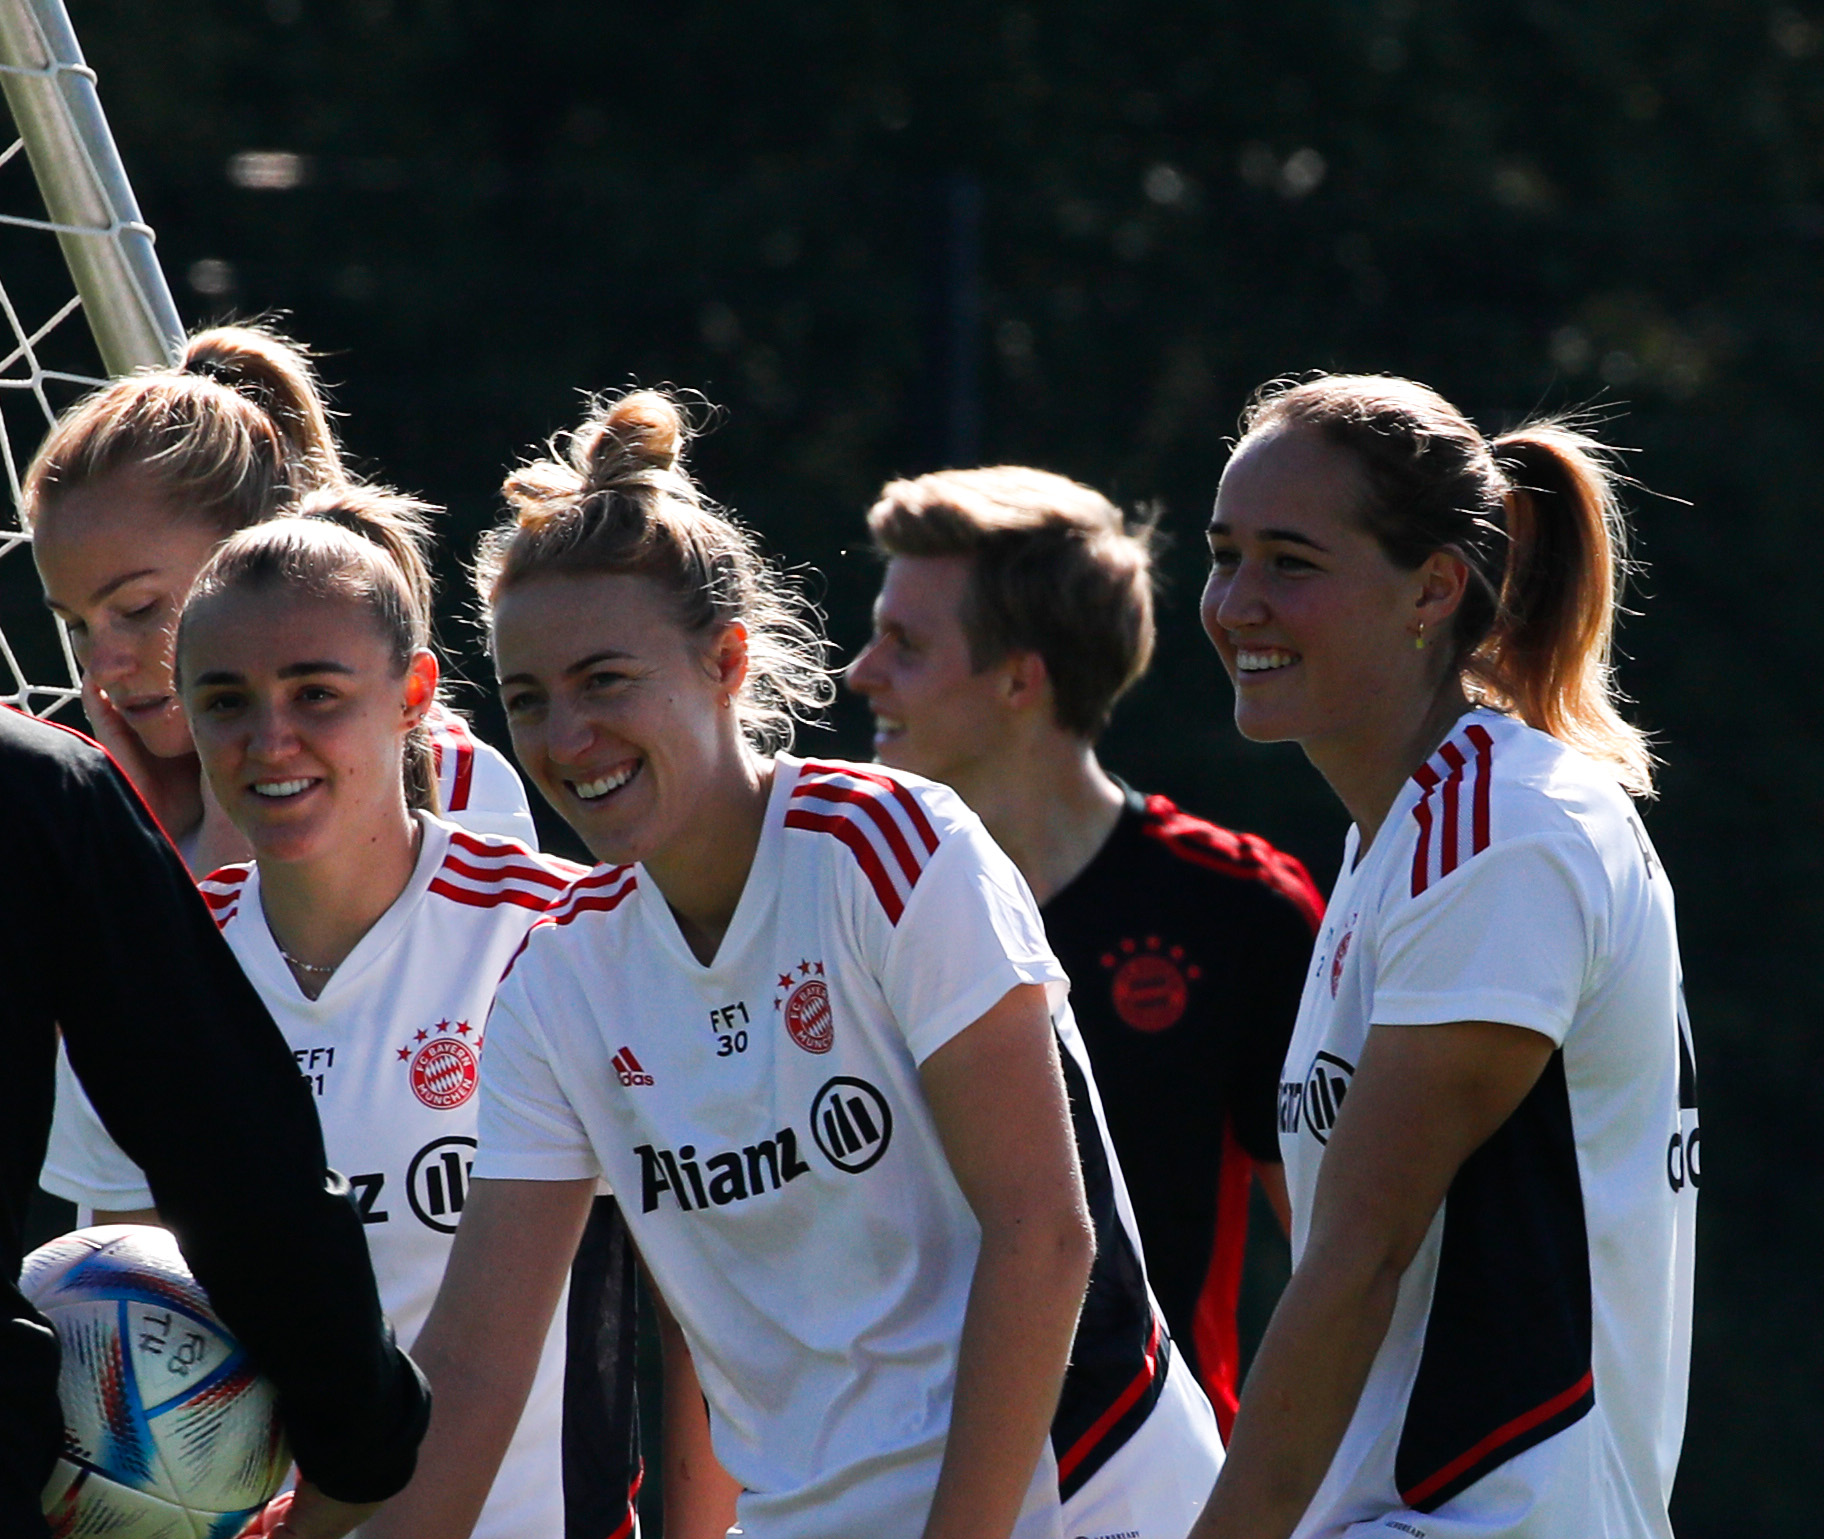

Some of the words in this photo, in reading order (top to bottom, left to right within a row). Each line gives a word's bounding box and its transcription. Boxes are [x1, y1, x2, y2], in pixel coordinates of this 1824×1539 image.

[709, 1002, 750, 1033] FF1
[427, 1043, 472, 1067] BAYERN
[716, 1031, 748, 1057] 30
